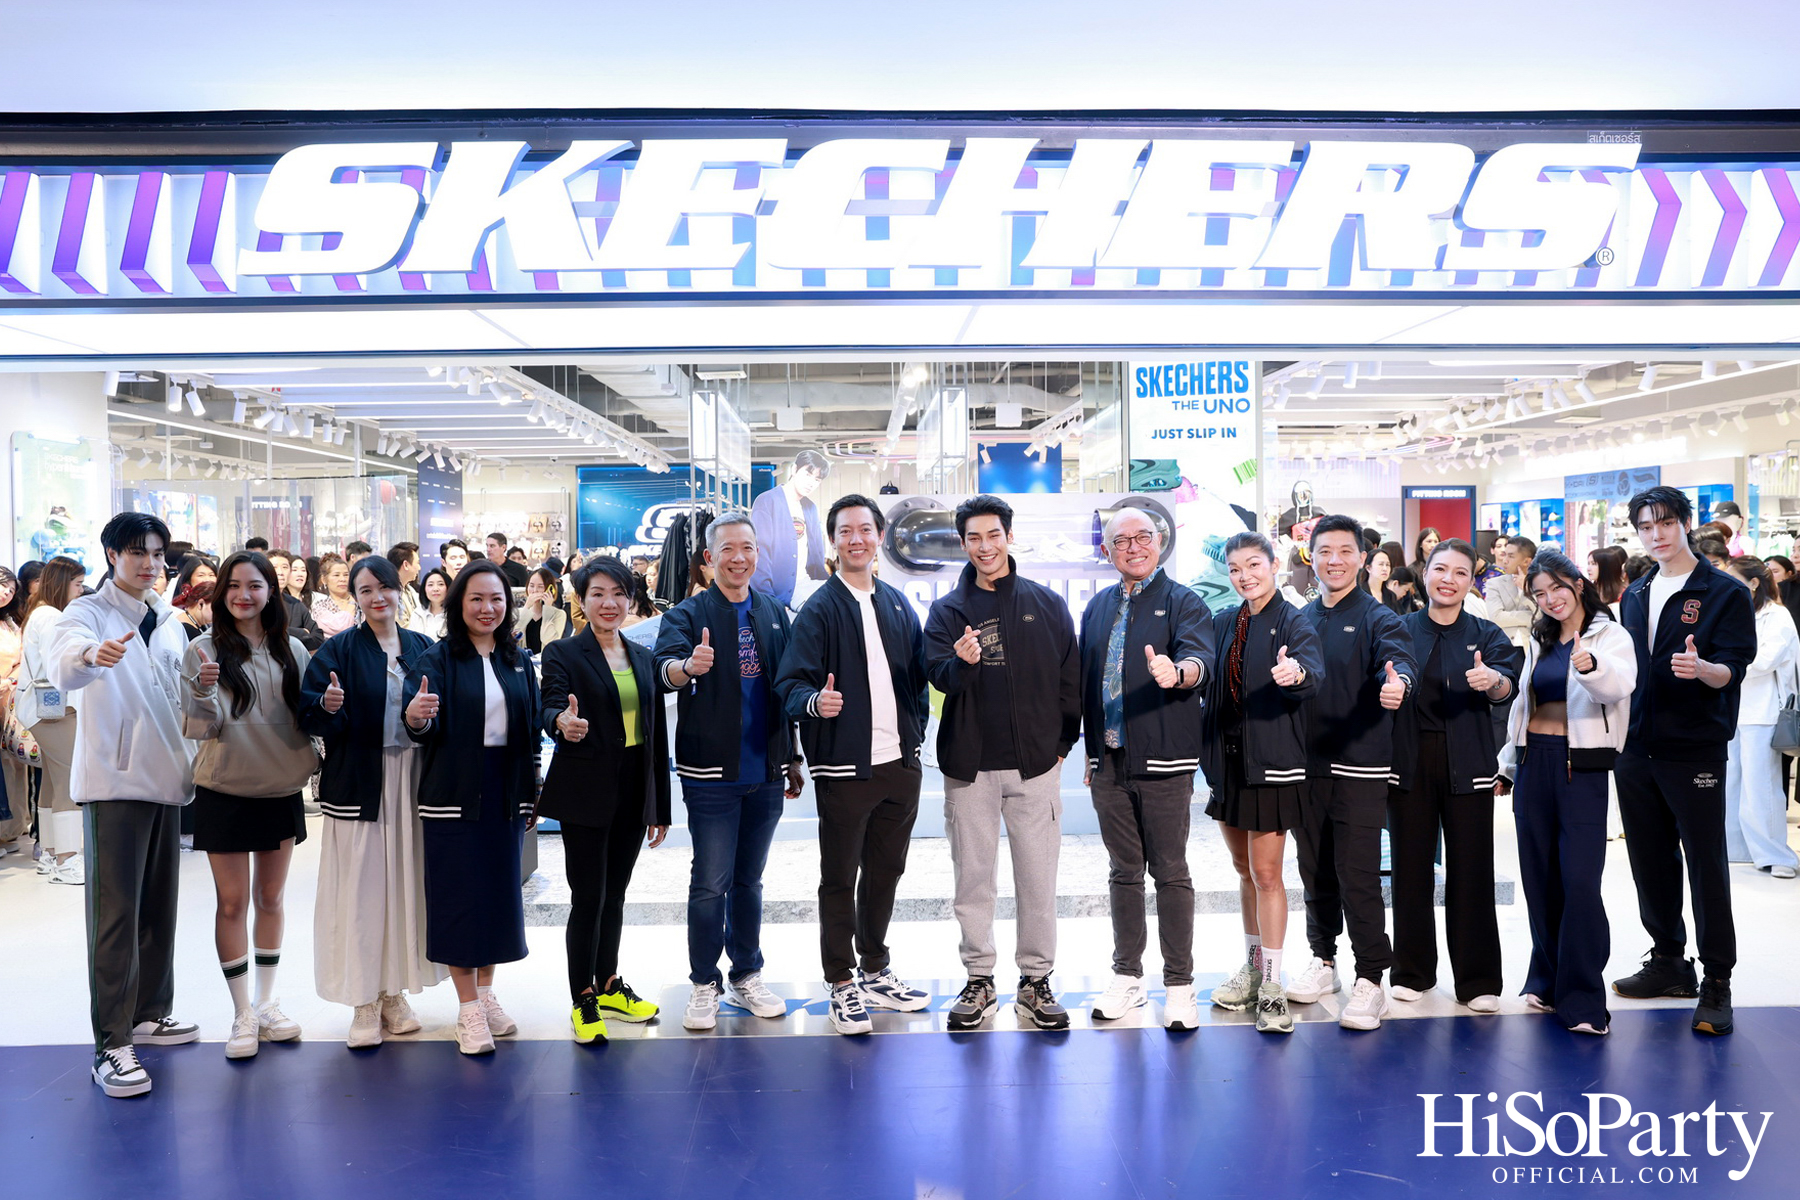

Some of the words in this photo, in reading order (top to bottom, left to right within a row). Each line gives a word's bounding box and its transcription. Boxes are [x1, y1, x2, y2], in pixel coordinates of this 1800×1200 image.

[237, 138, 1643, 276] SKECHERS
[1136, 361, 1249, 399] SKECHERS
[1172, 400, 1200, 411] THE
[1204, 398, 1251, 414] UNO
[1151, 429, 1184, 440] JUST
[1187, 428, 1217, 439] SLIP
[1221, 427, 1237, 438] IN
[1681, 599, 1702, 624] S
